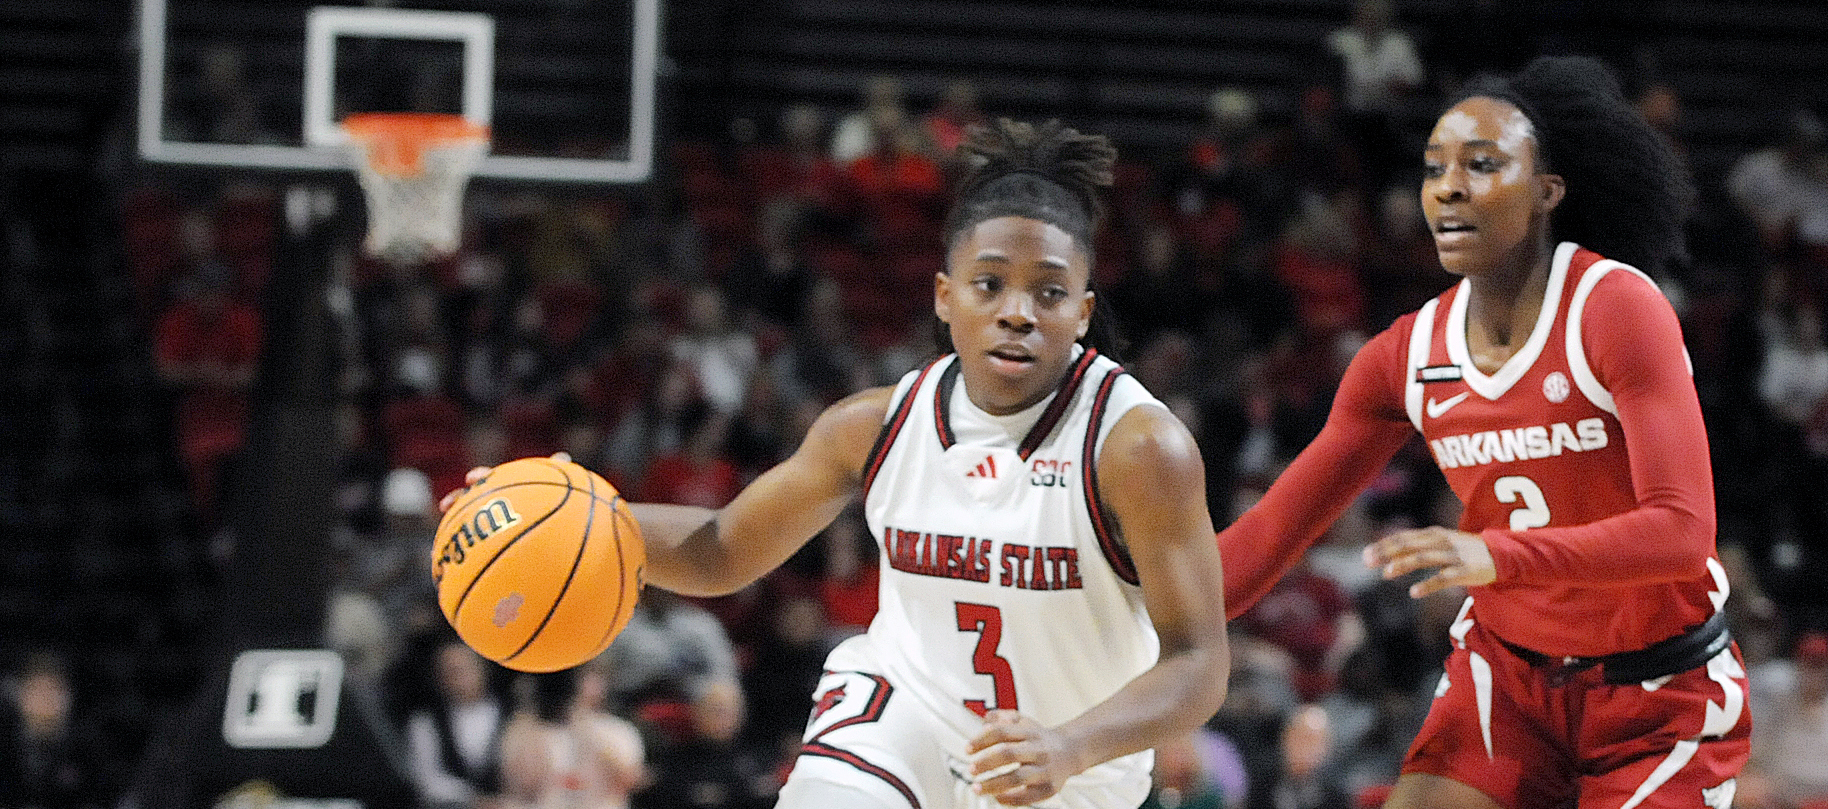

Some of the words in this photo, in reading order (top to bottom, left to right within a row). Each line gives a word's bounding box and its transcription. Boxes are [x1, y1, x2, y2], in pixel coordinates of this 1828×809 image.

[1494, 475, 1551, 532] 2
[1000, 542, 1083, 591] STATE
[954, 601, 1018, 718] 3
